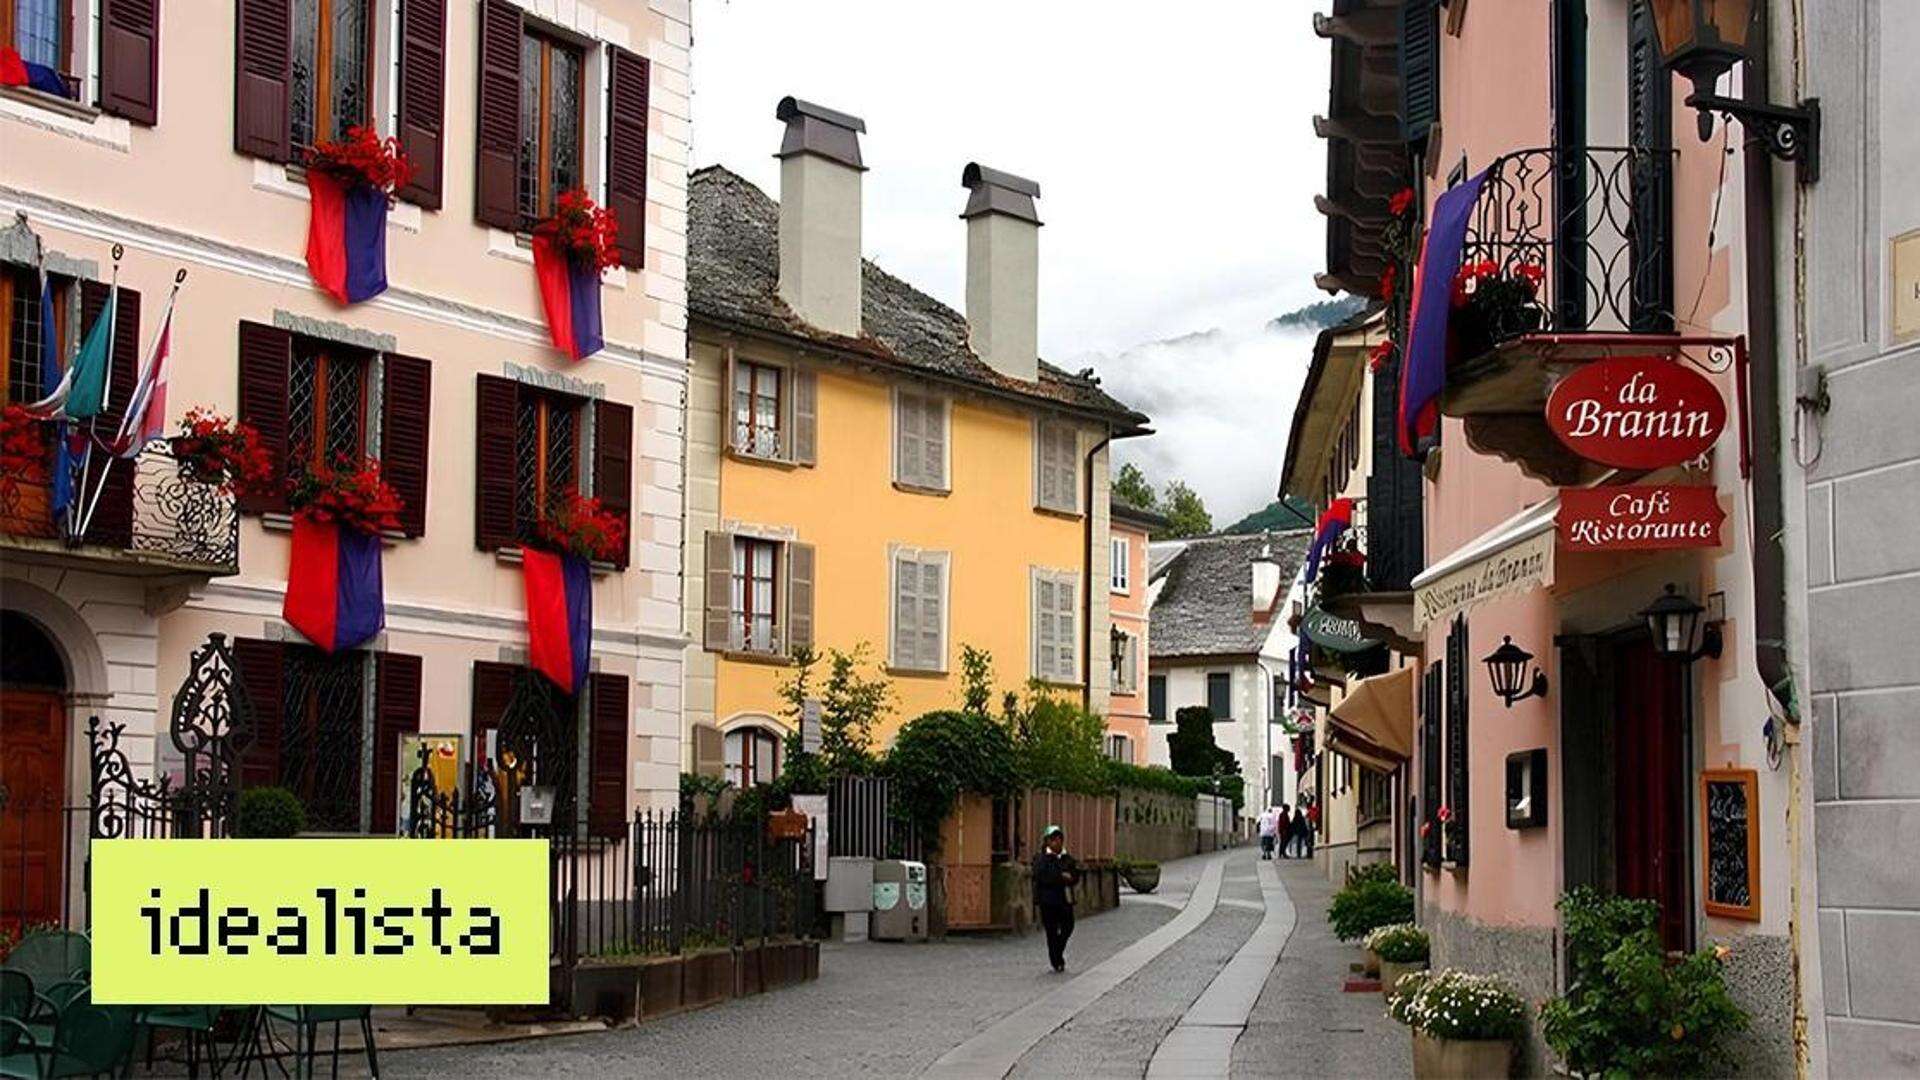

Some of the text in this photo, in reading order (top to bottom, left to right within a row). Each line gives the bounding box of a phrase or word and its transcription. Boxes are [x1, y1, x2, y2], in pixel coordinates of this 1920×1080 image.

[1619, 371, 1657, 404] da
[1566, 399, 1713, 438] Branin
[1609, 490, 1670, 521] Café
[1570, 519, 1712, 545] Ristorante
